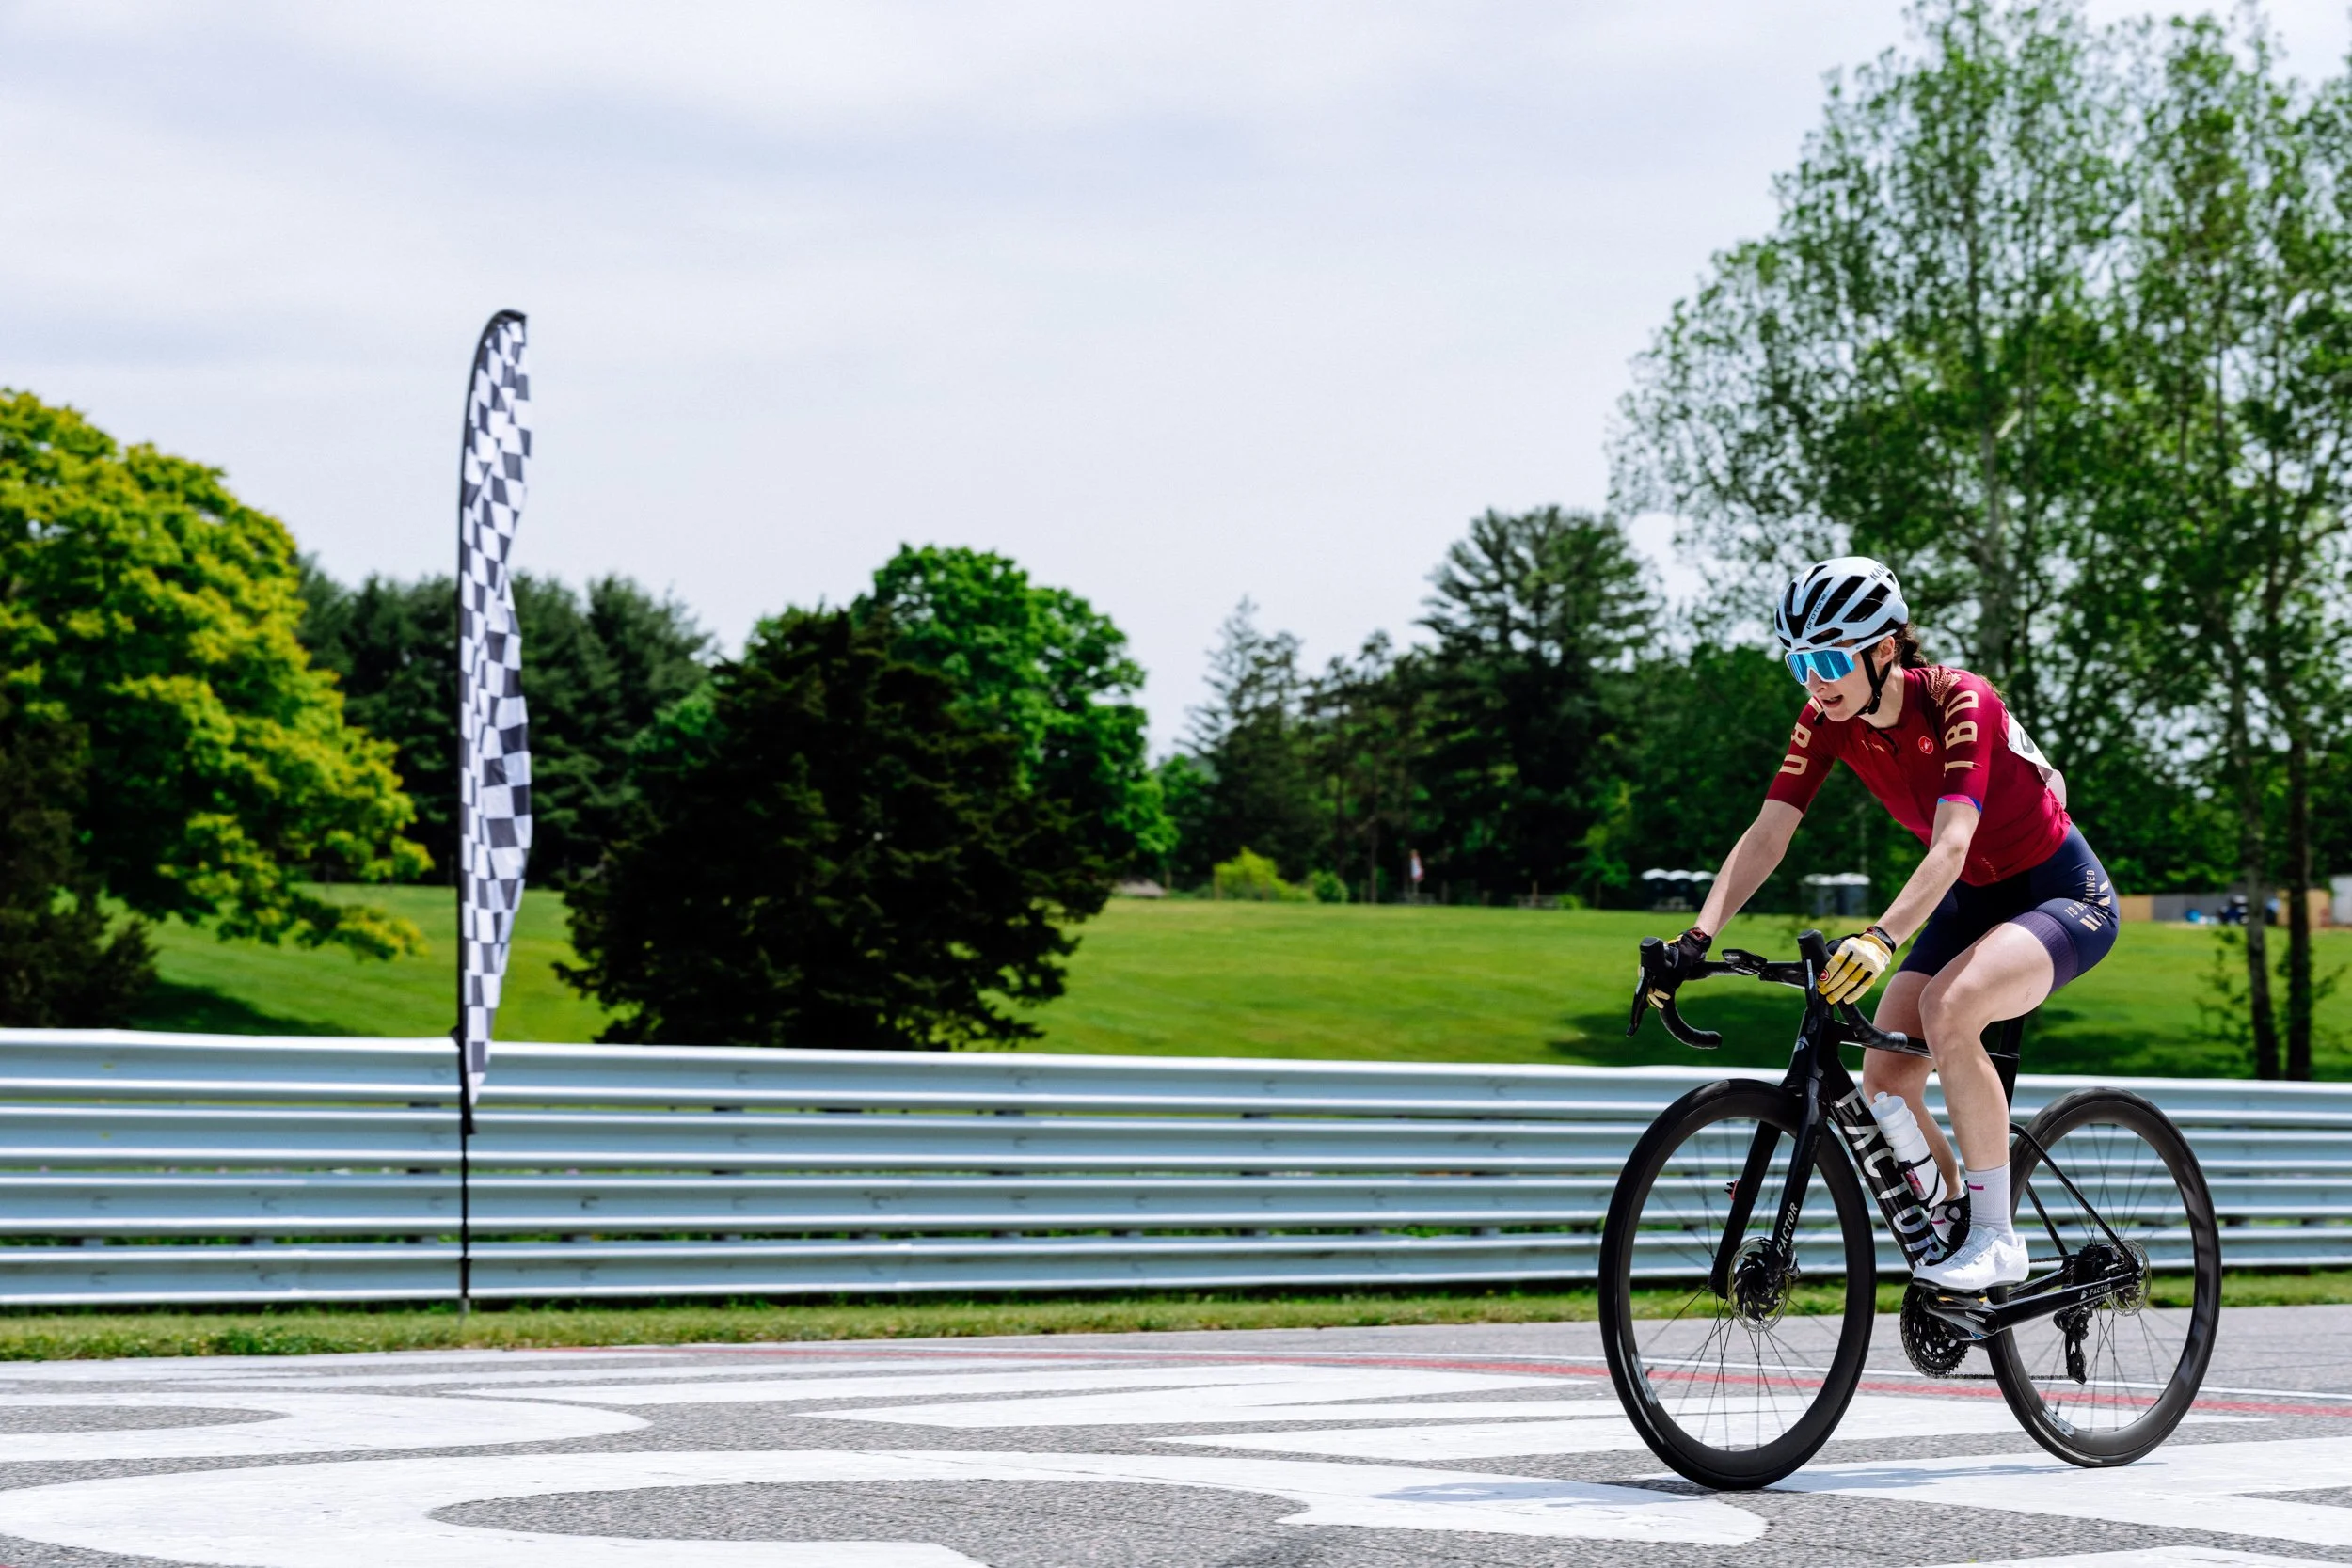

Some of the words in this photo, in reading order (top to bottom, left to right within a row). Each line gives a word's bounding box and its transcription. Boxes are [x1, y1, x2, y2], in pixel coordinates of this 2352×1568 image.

[2064, 906, 2078, 918] TO
[1836, 1088, 1947, 1267] FACTOR
[1776, 1202, 1798, 1257] FACTOR
[2090, 1283, 2112, 1296] FACTOR
